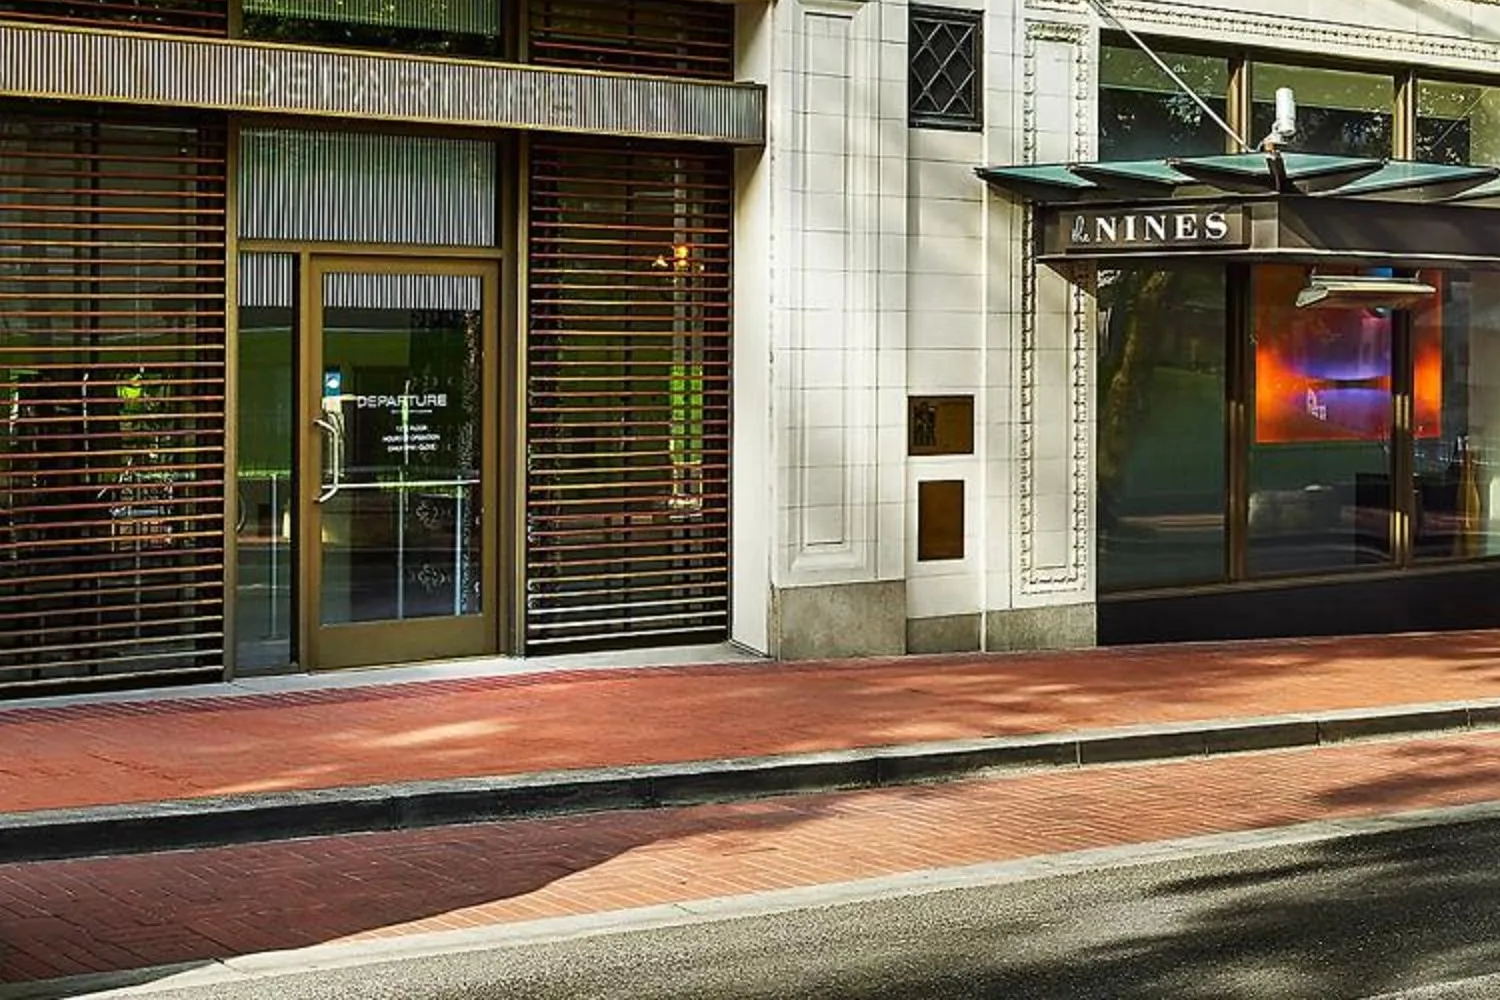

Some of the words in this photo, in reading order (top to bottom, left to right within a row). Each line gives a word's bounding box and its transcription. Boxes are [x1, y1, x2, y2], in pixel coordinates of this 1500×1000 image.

[235, 59, 577, 118] DEPARTURE
[1071, 215, 1091, 243] the
[1095, 212, 1228, 242] NINES
[357, 393, 448, 408] DEPARTURE
